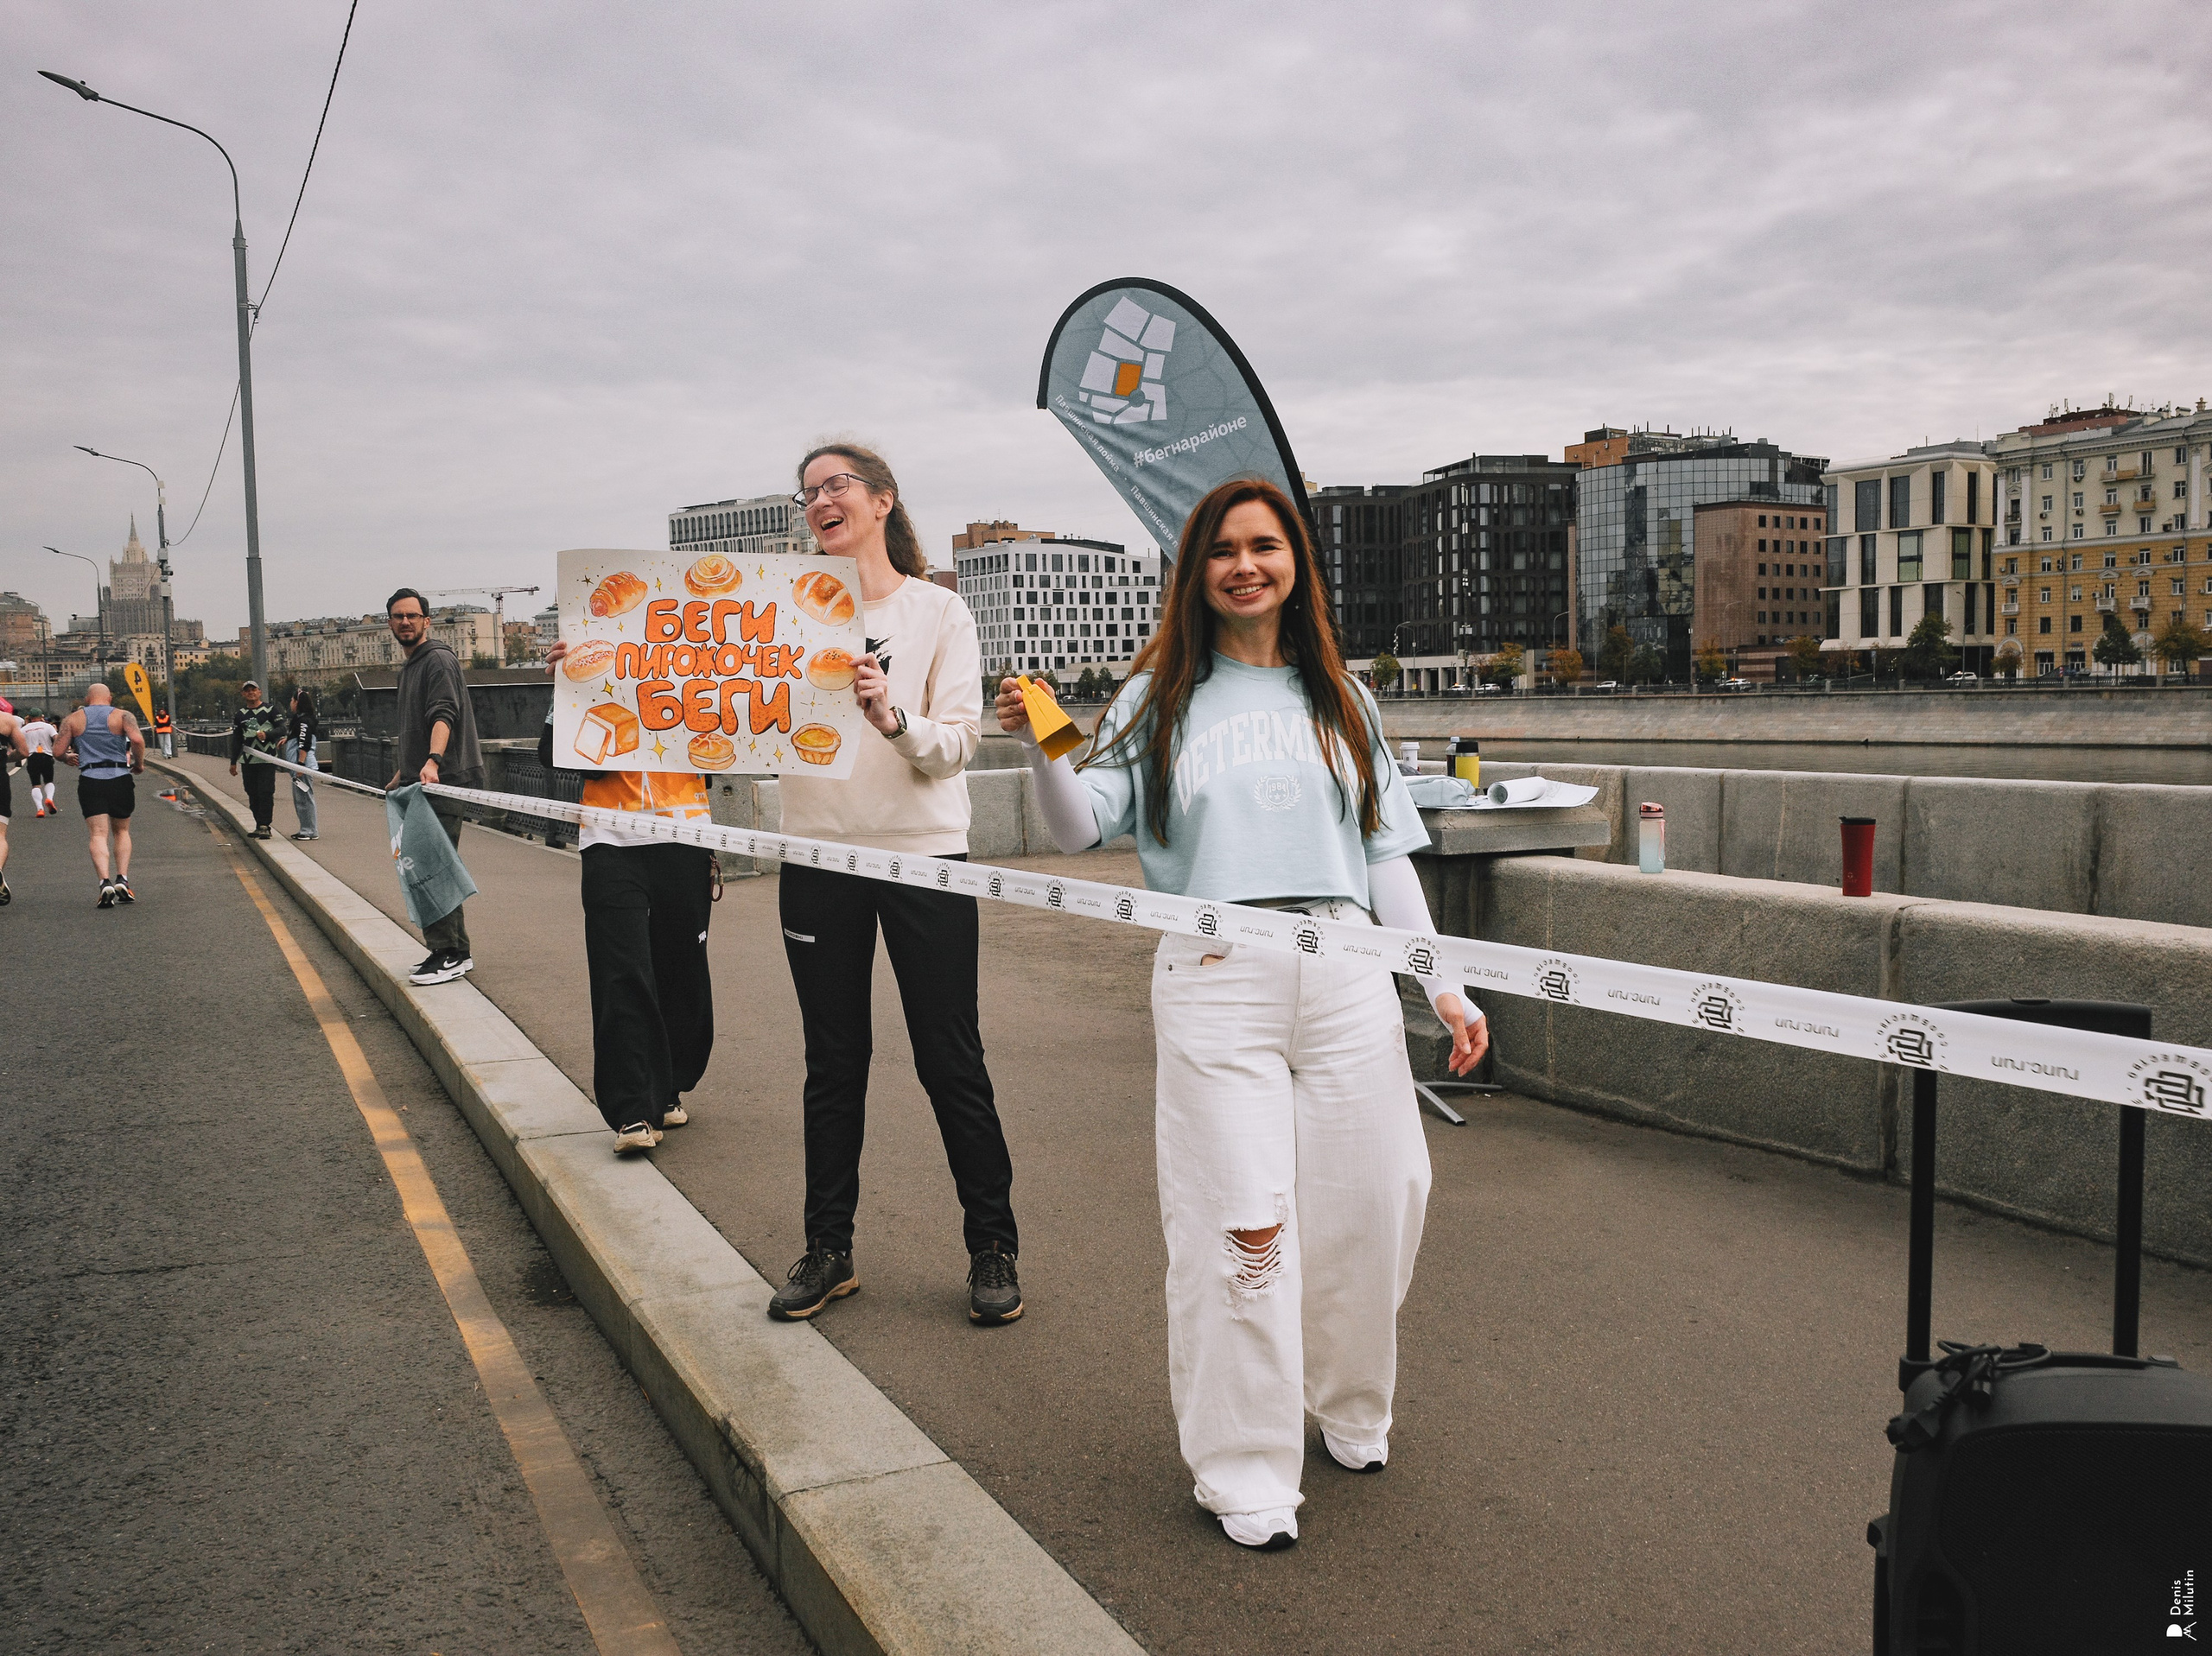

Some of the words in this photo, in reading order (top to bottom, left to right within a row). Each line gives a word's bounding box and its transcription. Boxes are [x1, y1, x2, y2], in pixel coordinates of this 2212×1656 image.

[1055, 394, 1099, 446] Павшинская
[1096, 445, 1120, 473] пойма
[1133, 415, 1248, 468] #бегнарайоне
[1130, 485, 1173, 541] Павшинская
[645, 599, 778, 645] БЕГИ
[614, 642, 805, 681] ПИРОЖОЧЕК
[636, 678, 792, 736] БЕГИ
[1174, 710, 1363, 816] DETERMI
[1268, 782, 1287, 793] 1984
[1239, 925, 1274, 938] runc.run
[1343, 943, 1381, 957] runc.run
[1463, 965, 1509, 980] runc.run
[1607, 988, 1661, 1006] runc.run
[1775, 1018, 1840, 1037] runc.run
[1991, 1055, 2079, 1081] runc.run
[2127, 1053, 2212, 1082] ОБЩЕСТВО
